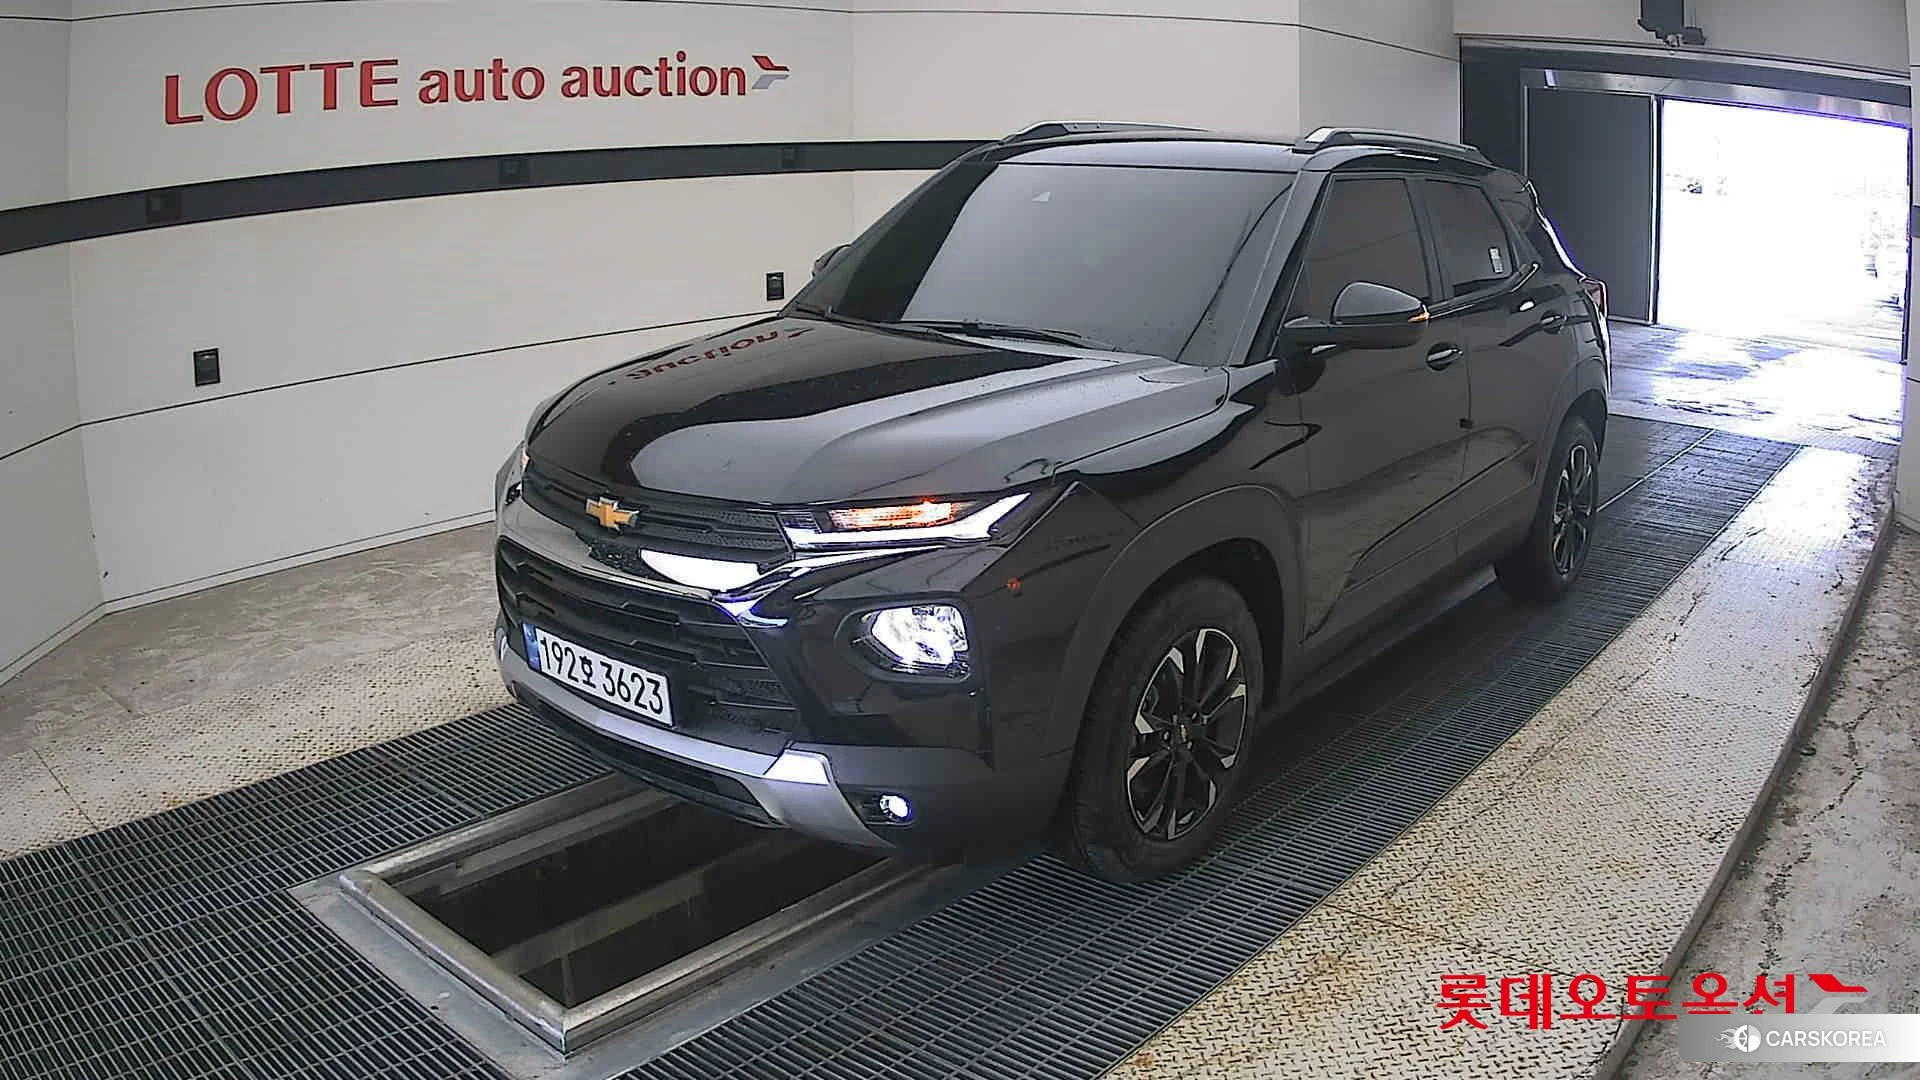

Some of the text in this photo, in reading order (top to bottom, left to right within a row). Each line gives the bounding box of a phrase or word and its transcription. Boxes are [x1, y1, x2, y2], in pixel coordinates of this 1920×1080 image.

[164, 49, 748, 125] LOTTE auto auction
